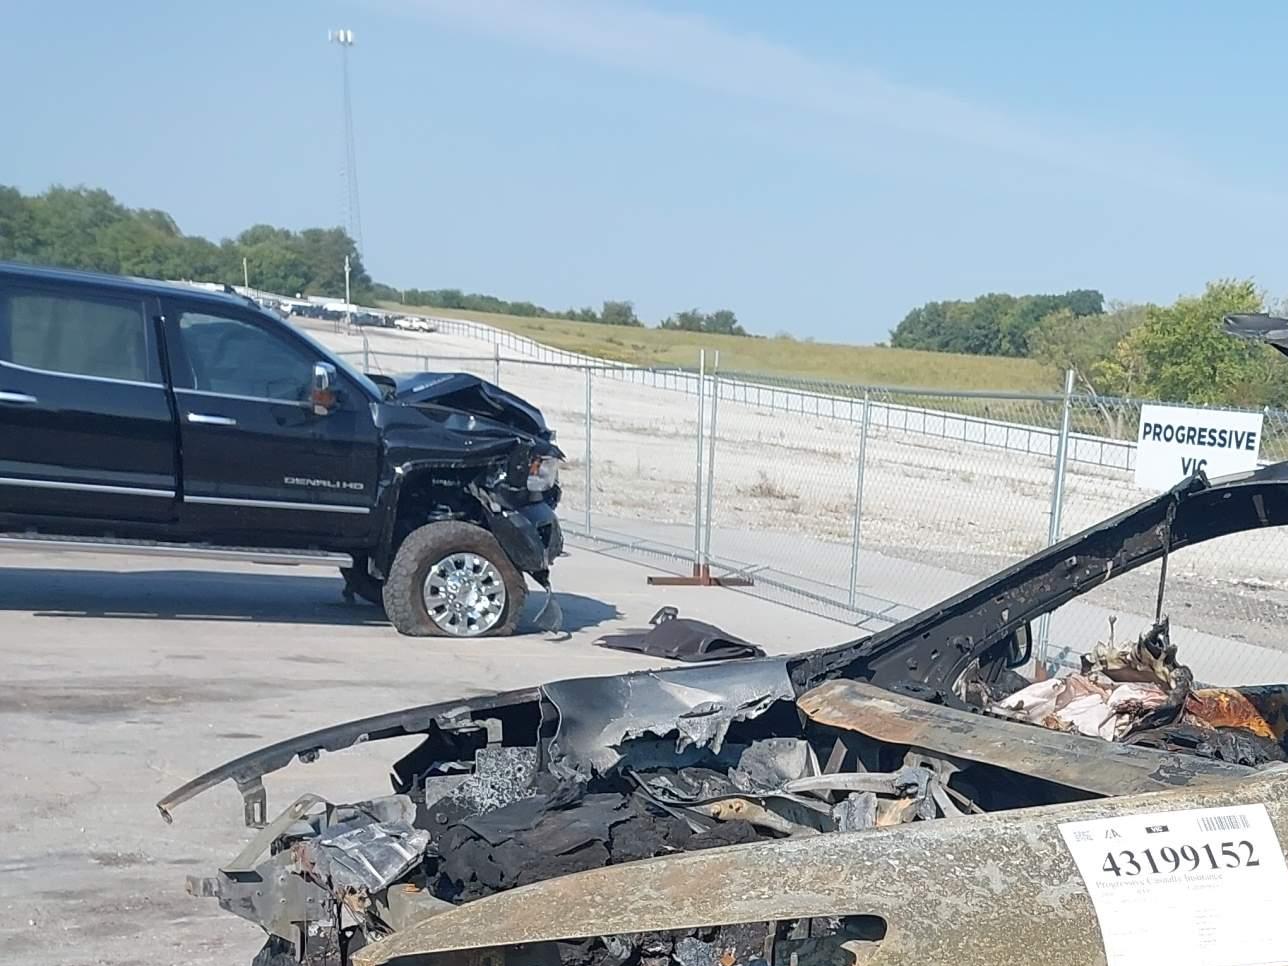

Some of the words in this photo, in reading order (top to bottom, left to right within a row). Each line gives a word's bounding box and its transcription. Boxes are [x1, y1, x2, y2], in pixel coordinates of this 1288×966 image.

[1142, 422, 1257, 451] PROGRESSIVE
[284, 476, 340, 488] DENALI
[342, 481, 364, 490] HD
[1102, 840, 1260, 877] 43199152
